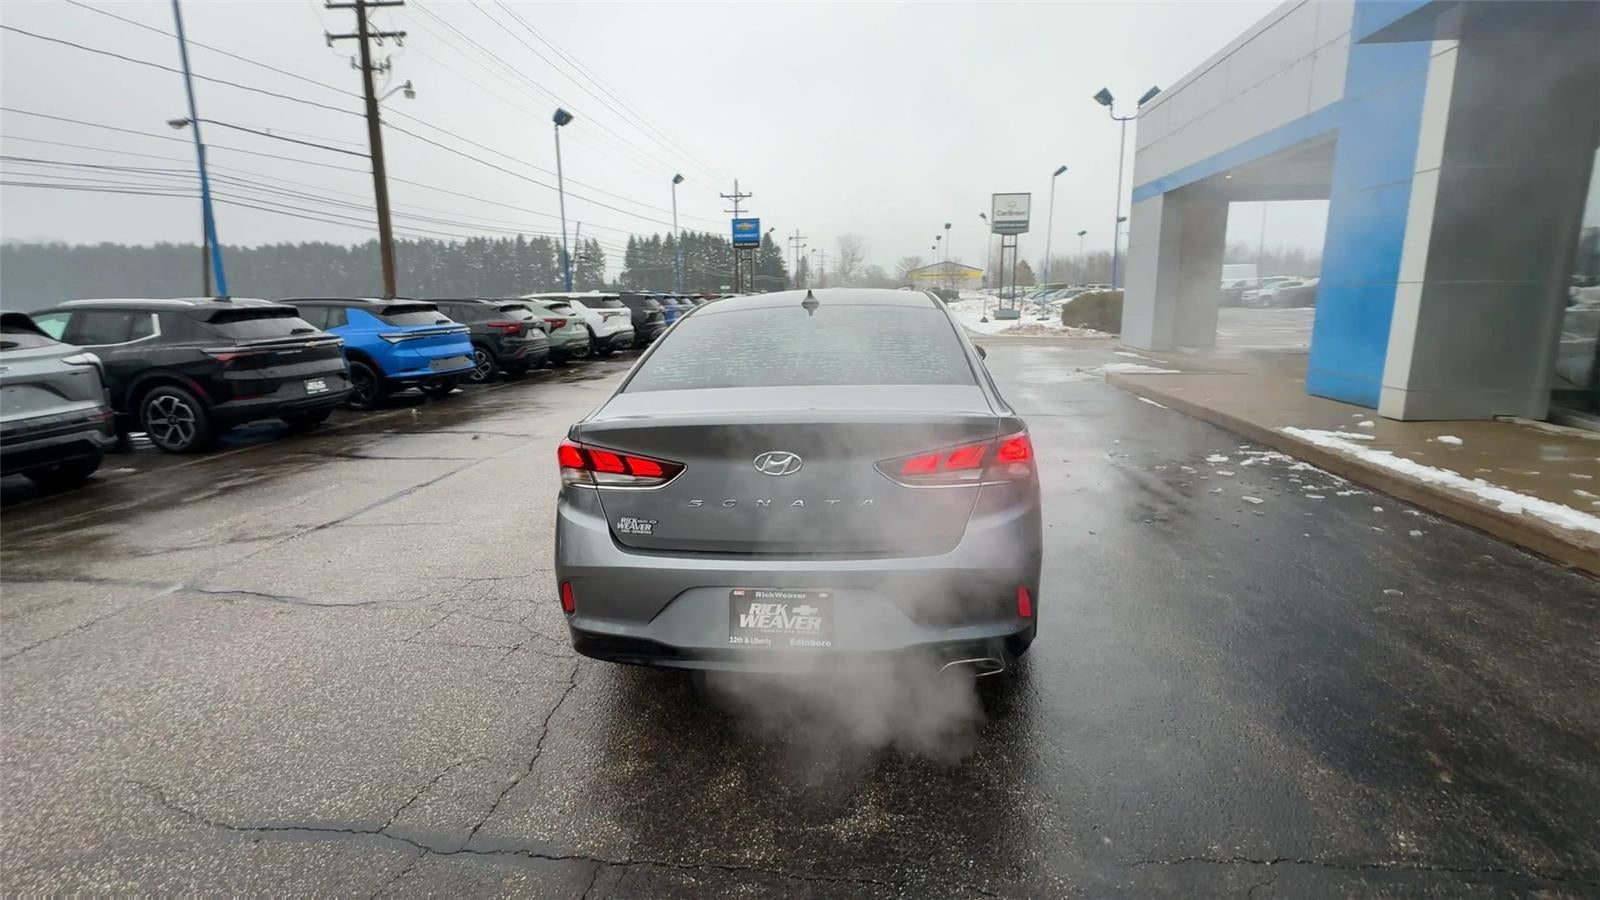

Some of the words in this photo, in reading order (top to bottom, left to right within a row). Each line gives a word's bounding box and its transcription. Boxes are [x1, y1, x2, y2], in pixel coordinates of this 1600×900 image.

[687, 498, 874, 508] SONATA
[617, 522, 652, 531] WEAVER
[749, 603, 787, 615] RICK
[740, 614, 822, 629] WEAVER
